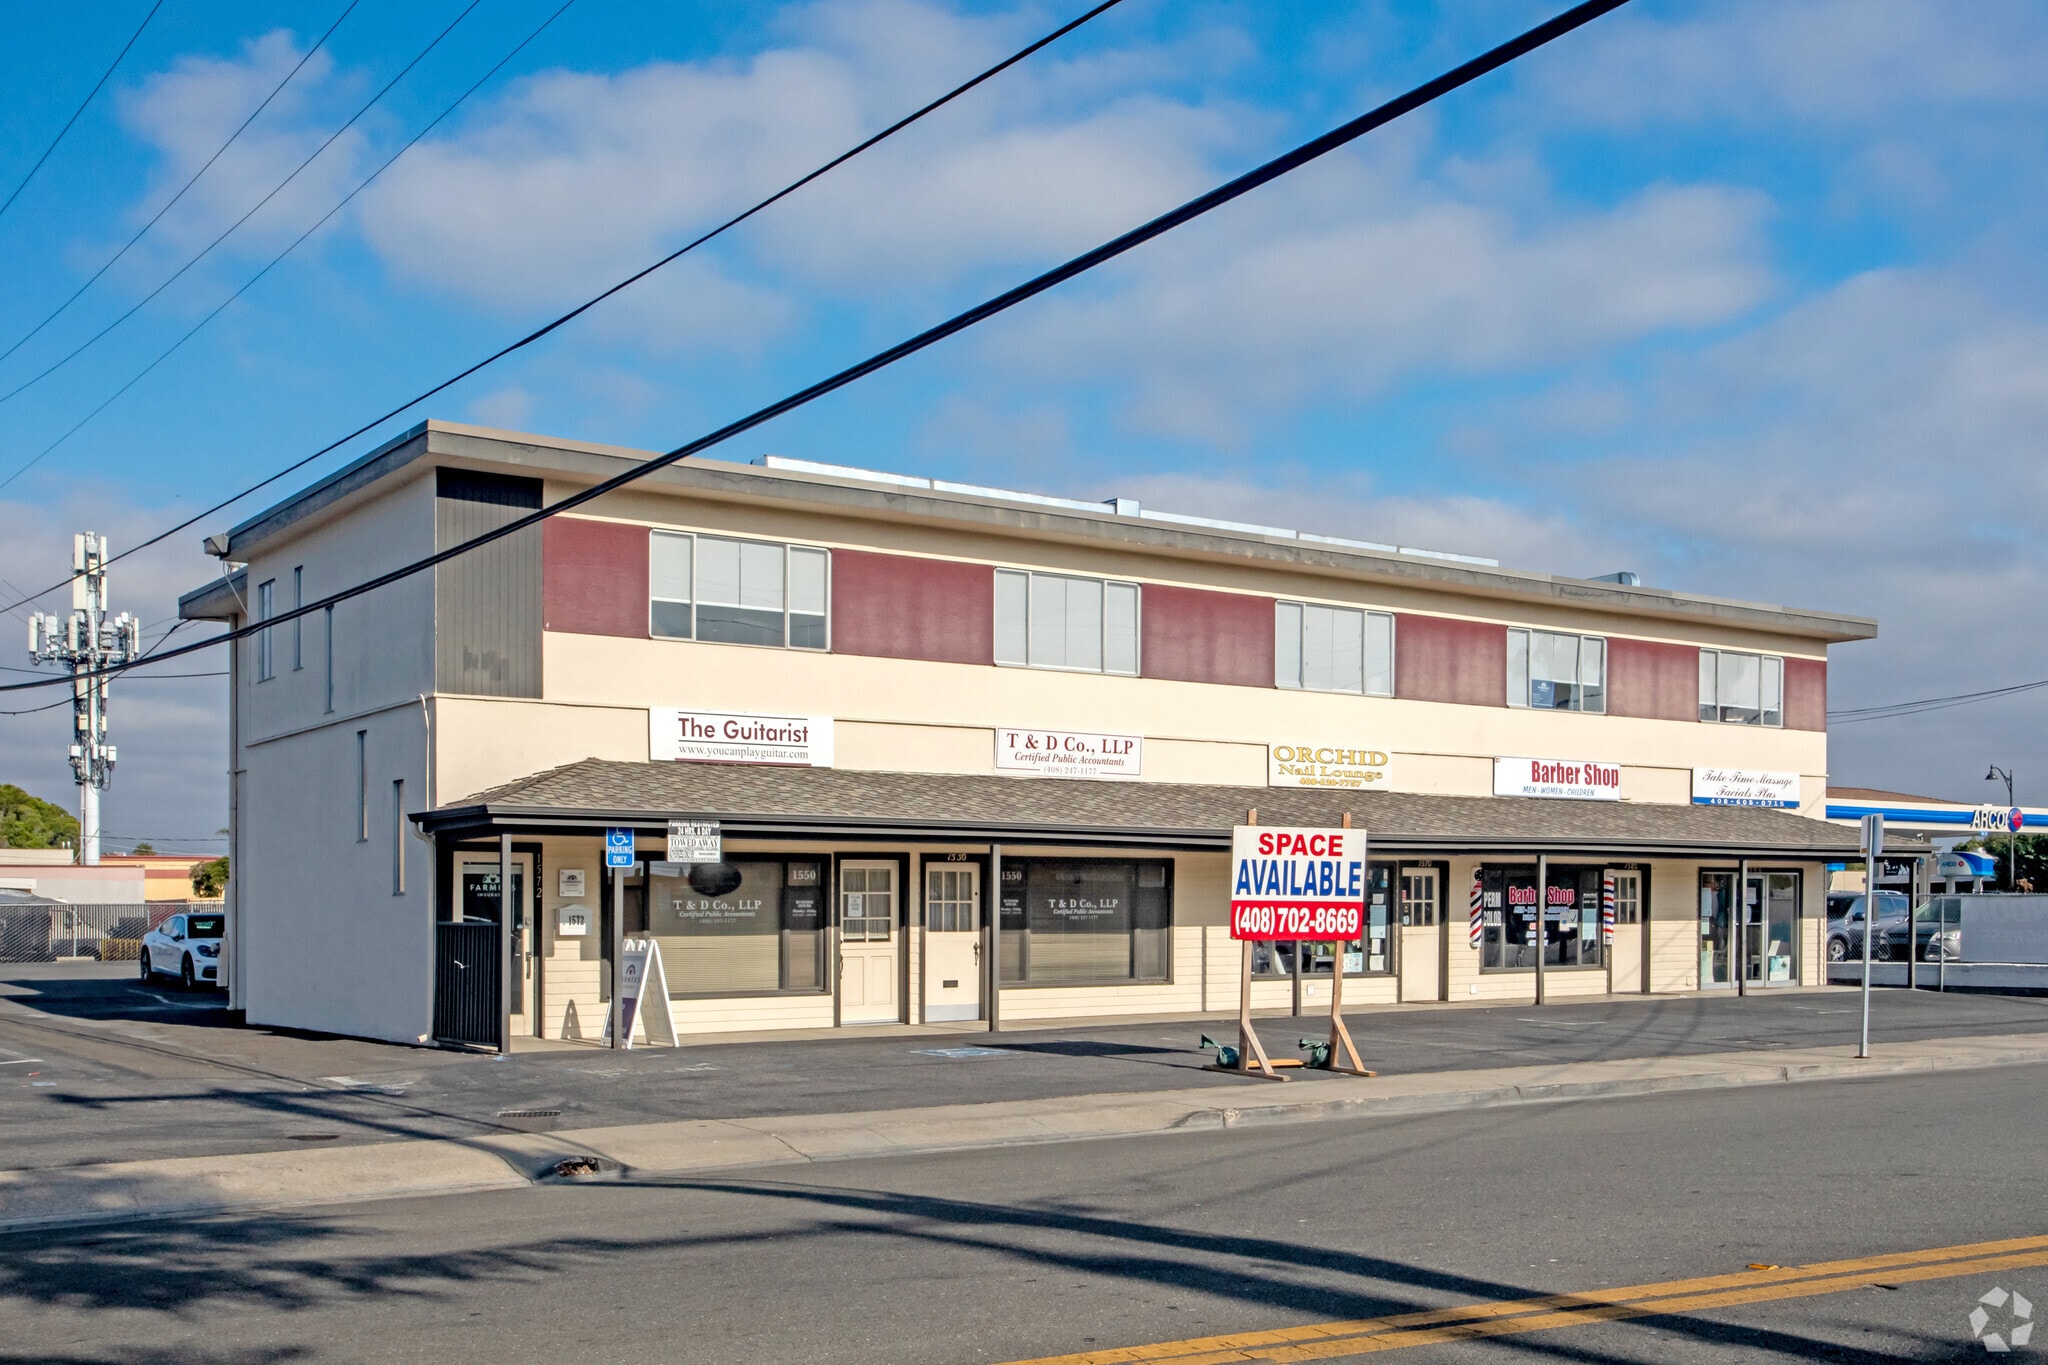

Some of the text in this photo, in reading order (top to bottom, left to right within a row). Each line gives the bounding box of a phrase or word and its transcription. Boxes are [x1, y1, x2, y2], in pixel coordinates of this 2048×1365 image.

[678, 717, 808, 743] The Guitarist
[1006, 733, 1133, 756] T & D Co., LLP
[679, 745, 808, 760] www.youcanplayguitar.com
[1014, 751, 1125, 766] Certified Public Accountants
[1273, 745, 1389, 767] ORCHID
[1043, 766, 1097, 775] (408) 247-1177
[1278, 763, 1383, 782] Nail Lounge
[1531, 760, 1619, 789] Barber Shop
[1702, 769, 1793, 789] Take Time Massage
[1522, 786, 1595, 796] MEN WOMEN CHILDREN
[1716, 785, 1776, 799] Facials Plus
[1710, 798, 1785, 807] 408-605-0715
[1970, 809, 2005, 829] ARCO
[677, 827, 685, 835] 24
[701, 828, 711, 836] DAY
[608, 845, 632, 855] PARKING
[670, 838, 718, 848] TOWED AWAY
[1258, 832, 1344, 857] SPACE
[612, 855, 628, 864] ONLY
[535, 853, 543, 898] 1572
[792, 870, 816, 880] 1550
[1001, 871, 1022, 880] 1550
[1235, 859, 1362, 897] AVAILABLE
[1048, 899, 1056, 908] T
[1058, 899, 1067, 908] &
[1070, 899, 1077, 908] D
[1100, 899, 1119, 908] LLP
[1483, 891, 1501, 907] PERM
[1547, 886, 1575, 906] Shop
[673, 900, 682, 910] T
[686, 900, 696, 910] &
[700, 900, 709, 910] D
[738, 900, 762, 910] LLP
[568, 915, 585, 926] 1572
[1235, 905, 1358, 935] (408) 702-8669
[1483, 911, 1502, 927] COLOR
